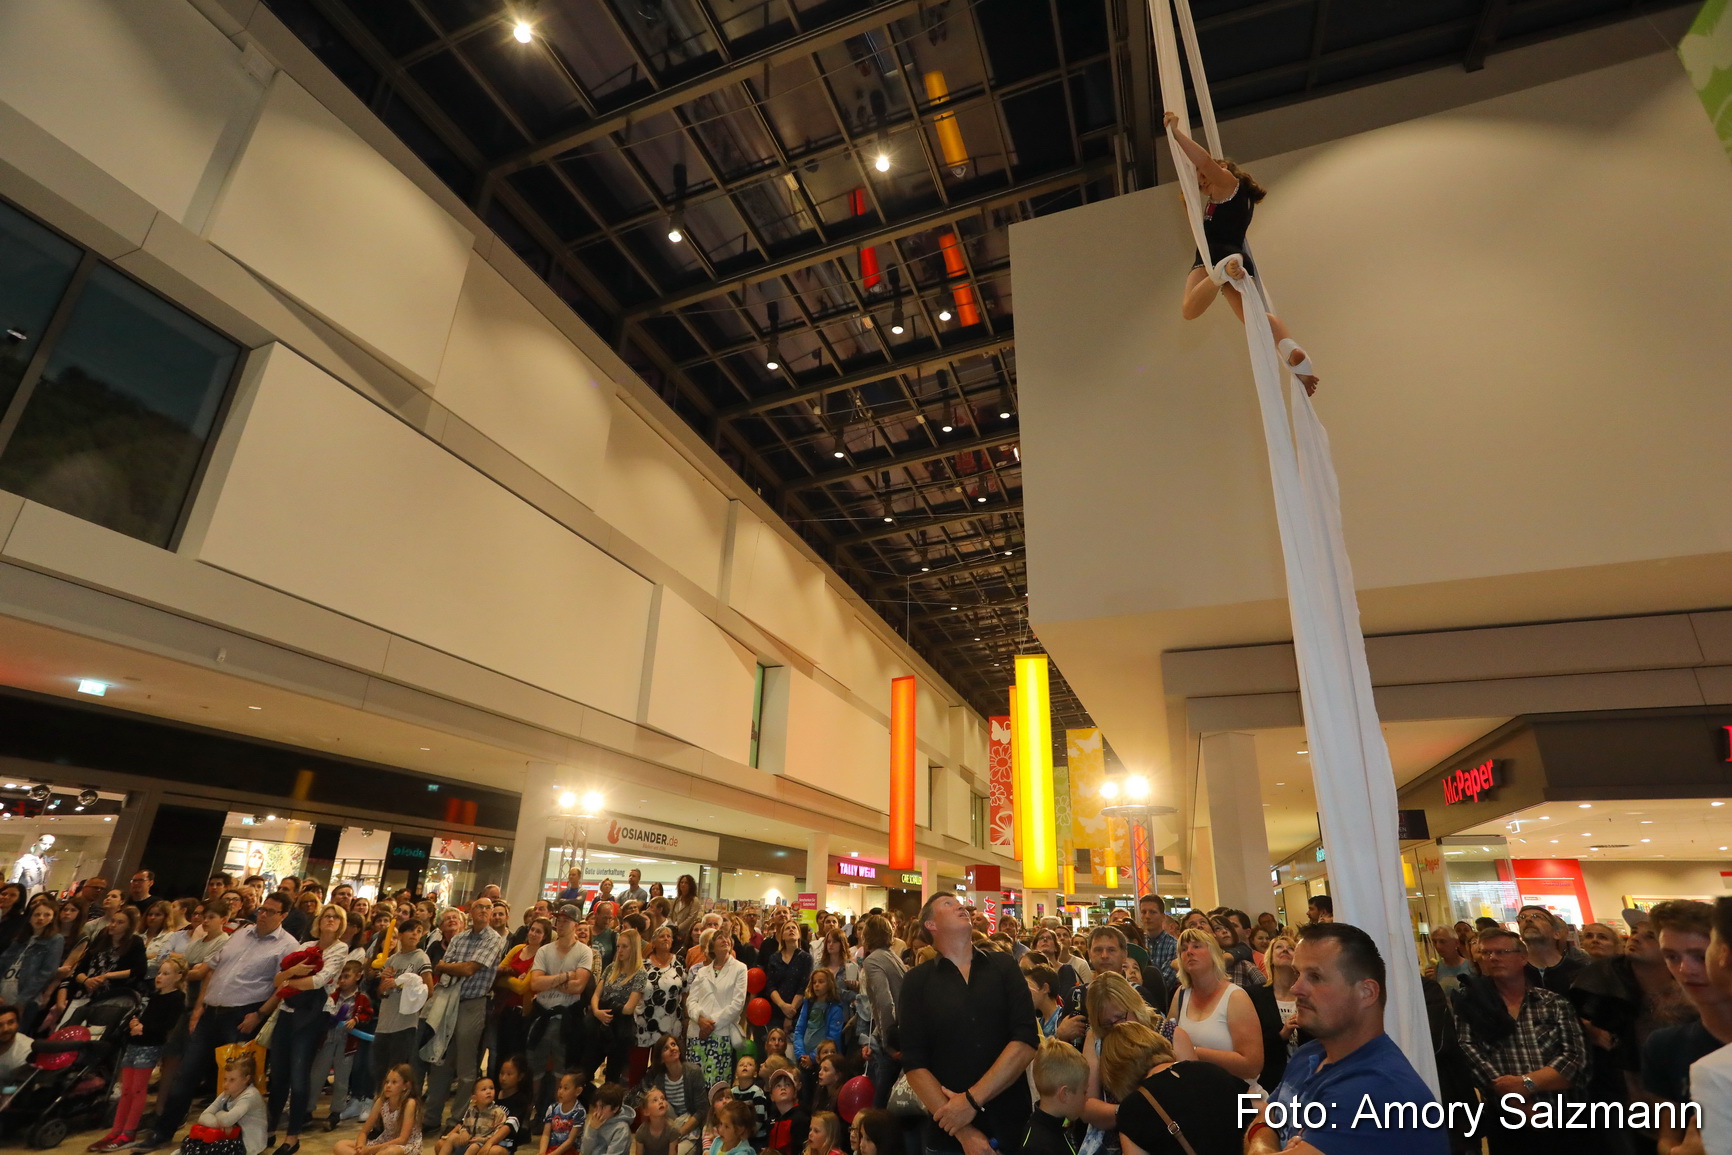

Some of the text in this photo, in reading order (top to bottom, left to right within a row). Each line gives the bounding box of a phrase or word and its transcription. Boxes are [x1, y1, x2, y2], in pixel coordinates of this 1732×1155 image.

[1442, 759, 1494, 806] McPaper
[621, 827, 678, 847] OSIANDER.de
[584, 867, 626, 878] Gute Unterhaltung
